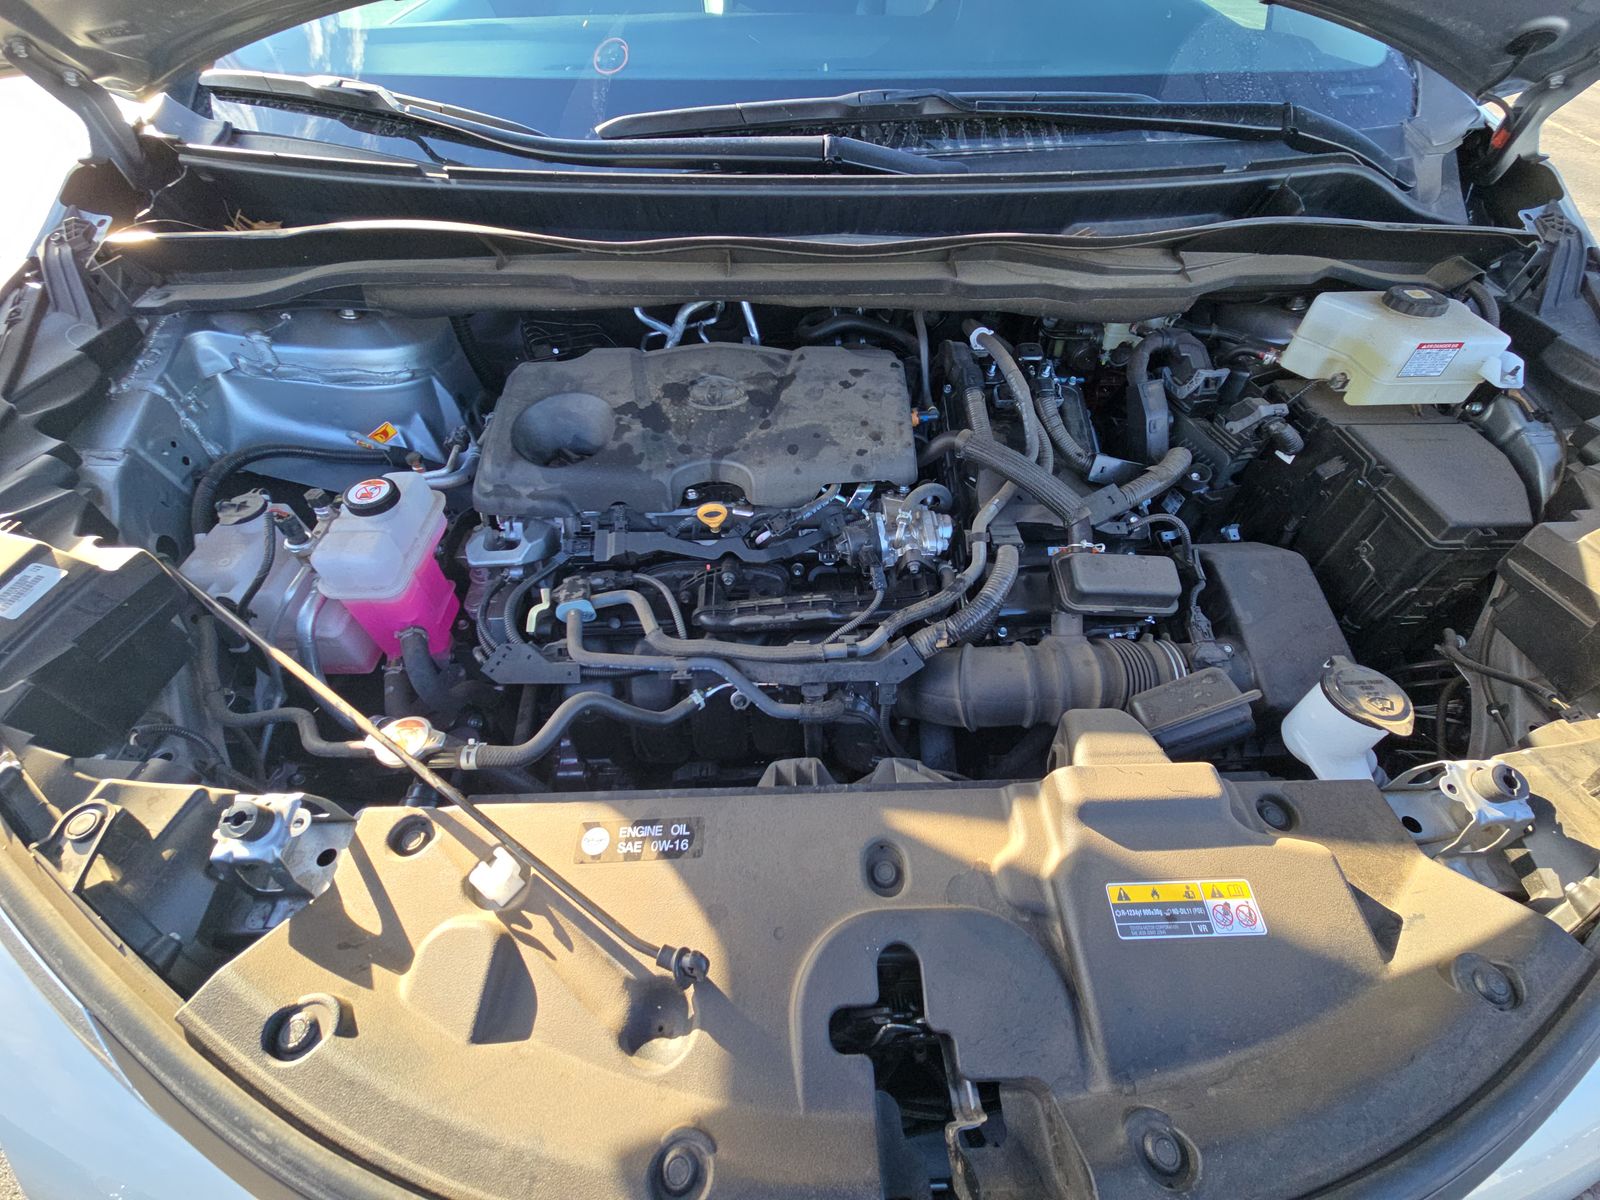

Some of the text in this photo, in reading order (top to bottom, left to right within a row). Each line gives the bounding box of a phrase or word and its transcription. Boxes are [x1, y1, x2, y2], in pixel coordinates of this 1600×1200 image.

[619, 824, 690, 838] ENGINE OIL
[617, 841, 643, 854] SAE
[650, 839, 689, 852] 0W-16
[1197, 925, 1209, 933] VR
